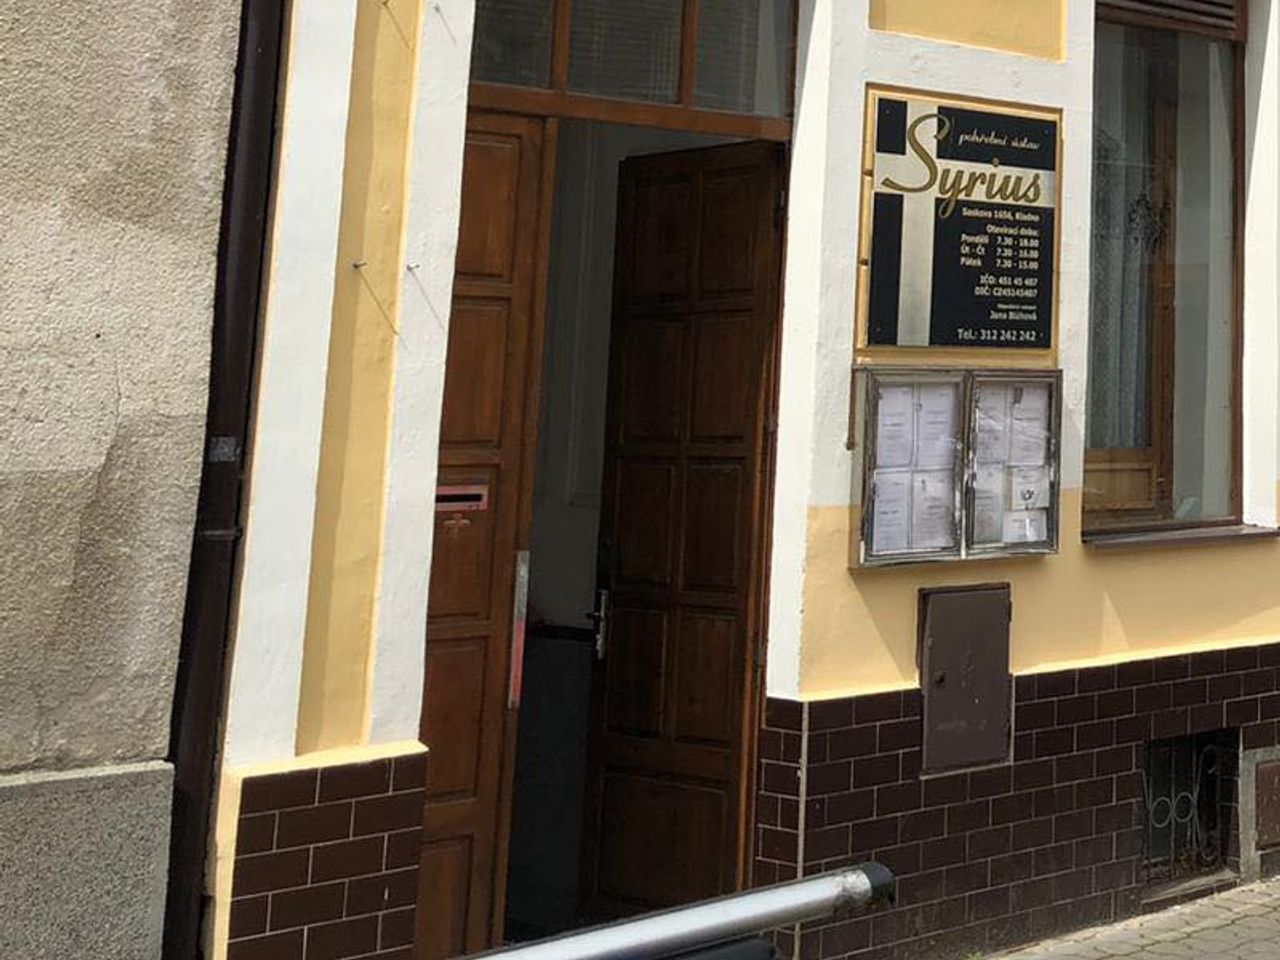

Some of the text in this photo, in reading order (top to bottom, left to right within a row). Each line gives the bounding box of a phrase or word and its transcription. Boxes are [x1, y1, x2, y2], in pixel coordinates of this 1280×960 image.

[881, 113, 1042, 219] Syrius
[980, 329, 998, 341] 312
[1000, 329, 1018, 341] 242
[1019, 330, 1037, 341] 242
